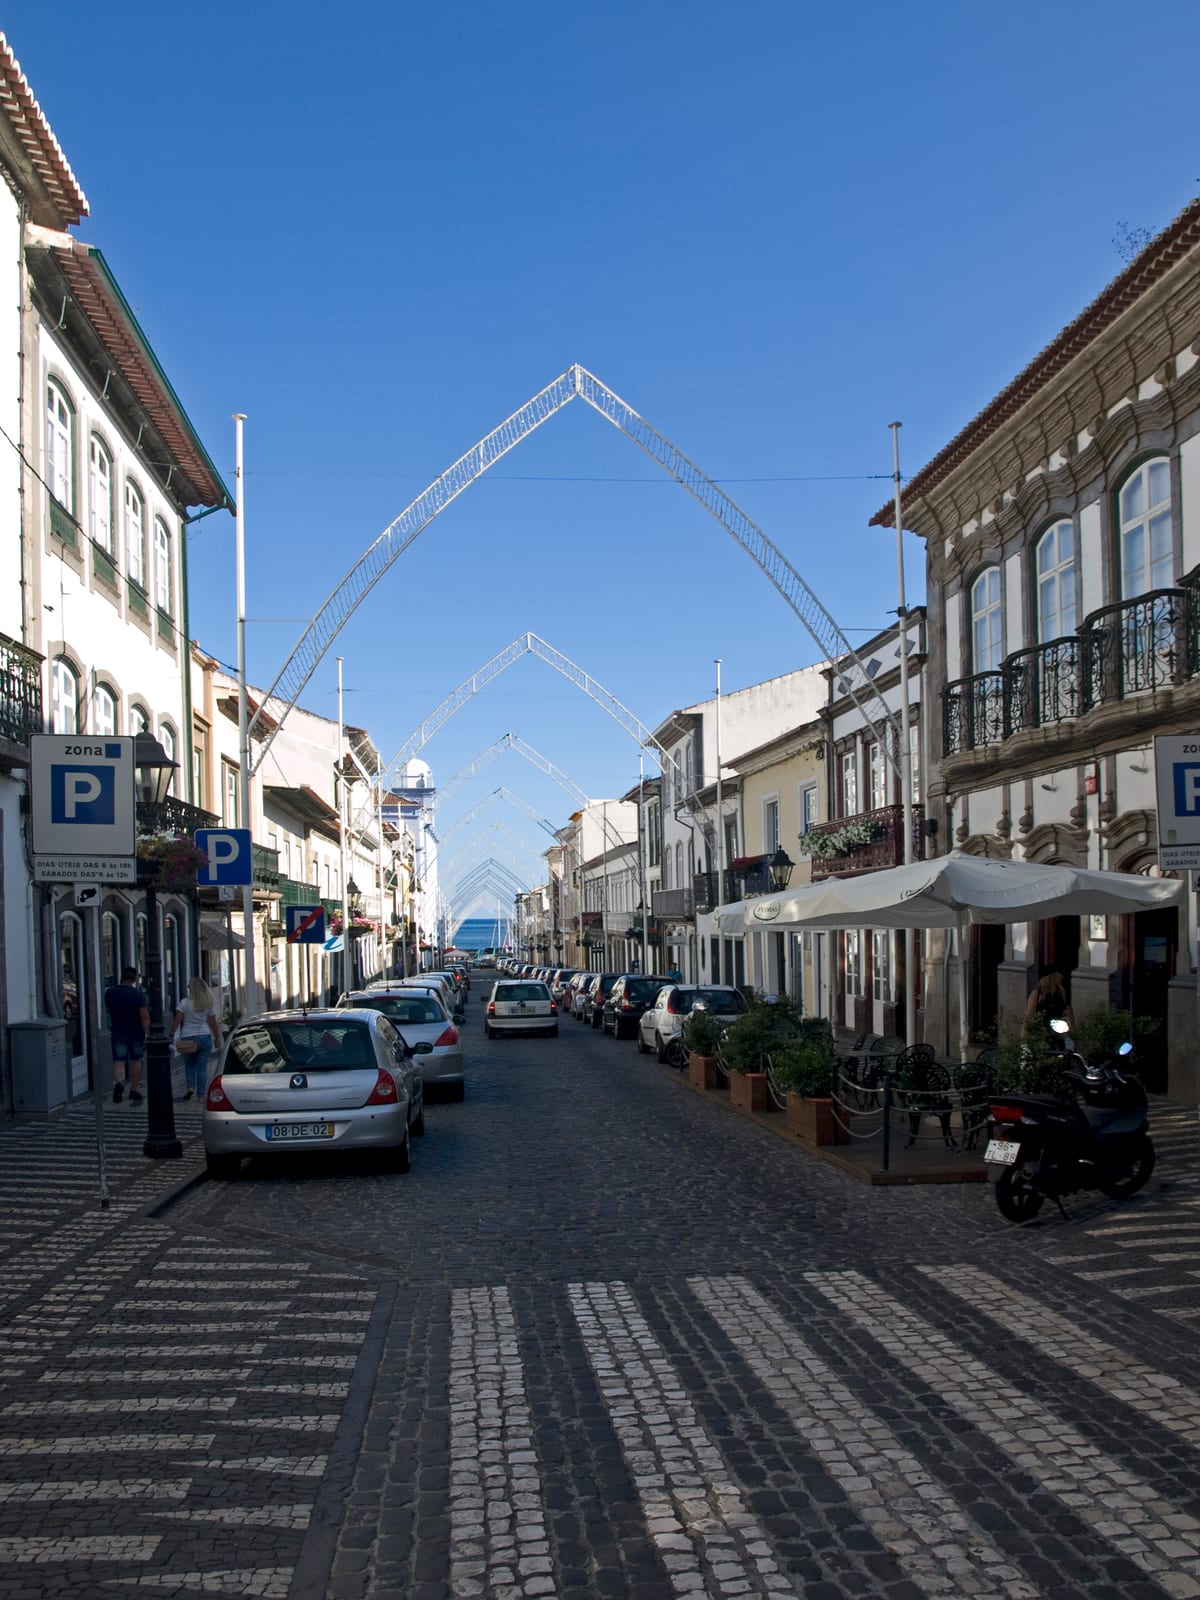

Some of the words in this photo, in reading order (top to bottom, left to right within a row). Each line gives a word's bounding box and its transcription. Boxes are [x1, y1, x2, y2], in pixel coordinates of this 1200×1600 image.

[64, 745, 103, 756] zona
[64, 772, 102, 818] P
[207, 834, 240, 881] P
